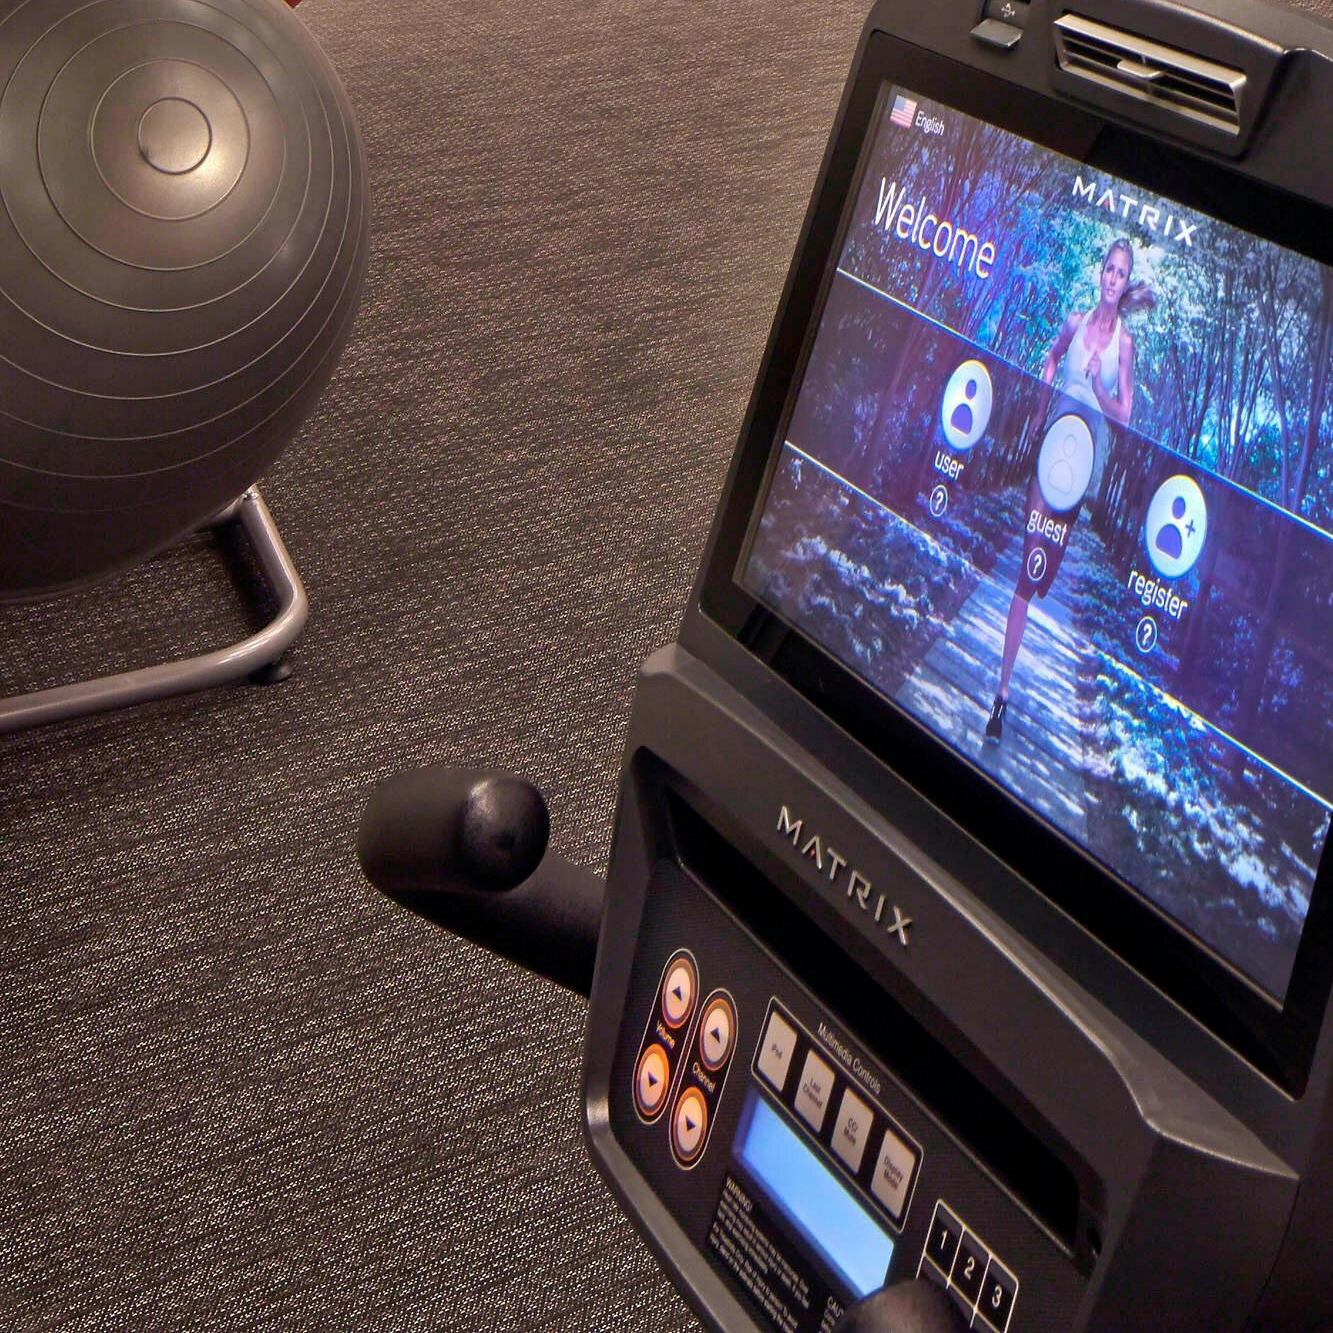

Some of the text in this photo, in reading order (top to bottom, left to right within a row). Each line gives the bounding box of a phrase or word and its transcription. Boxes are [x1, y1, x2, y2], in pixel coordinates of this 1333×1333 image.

[915, 110, 945, 136] English
[873, 176, 996, 279] Welcome
[1072, 175, 1199, 246] MATRIX
[934, 450, 964, 481] user
[1026, 509, 1068, 546] guest
[1127, 569, 1188, 620] register
[777, 805, 914, 946] MATRIX
[818, 1022, 853, 1065] Multimedia
[692, 1062, 715, 1094] Channel
